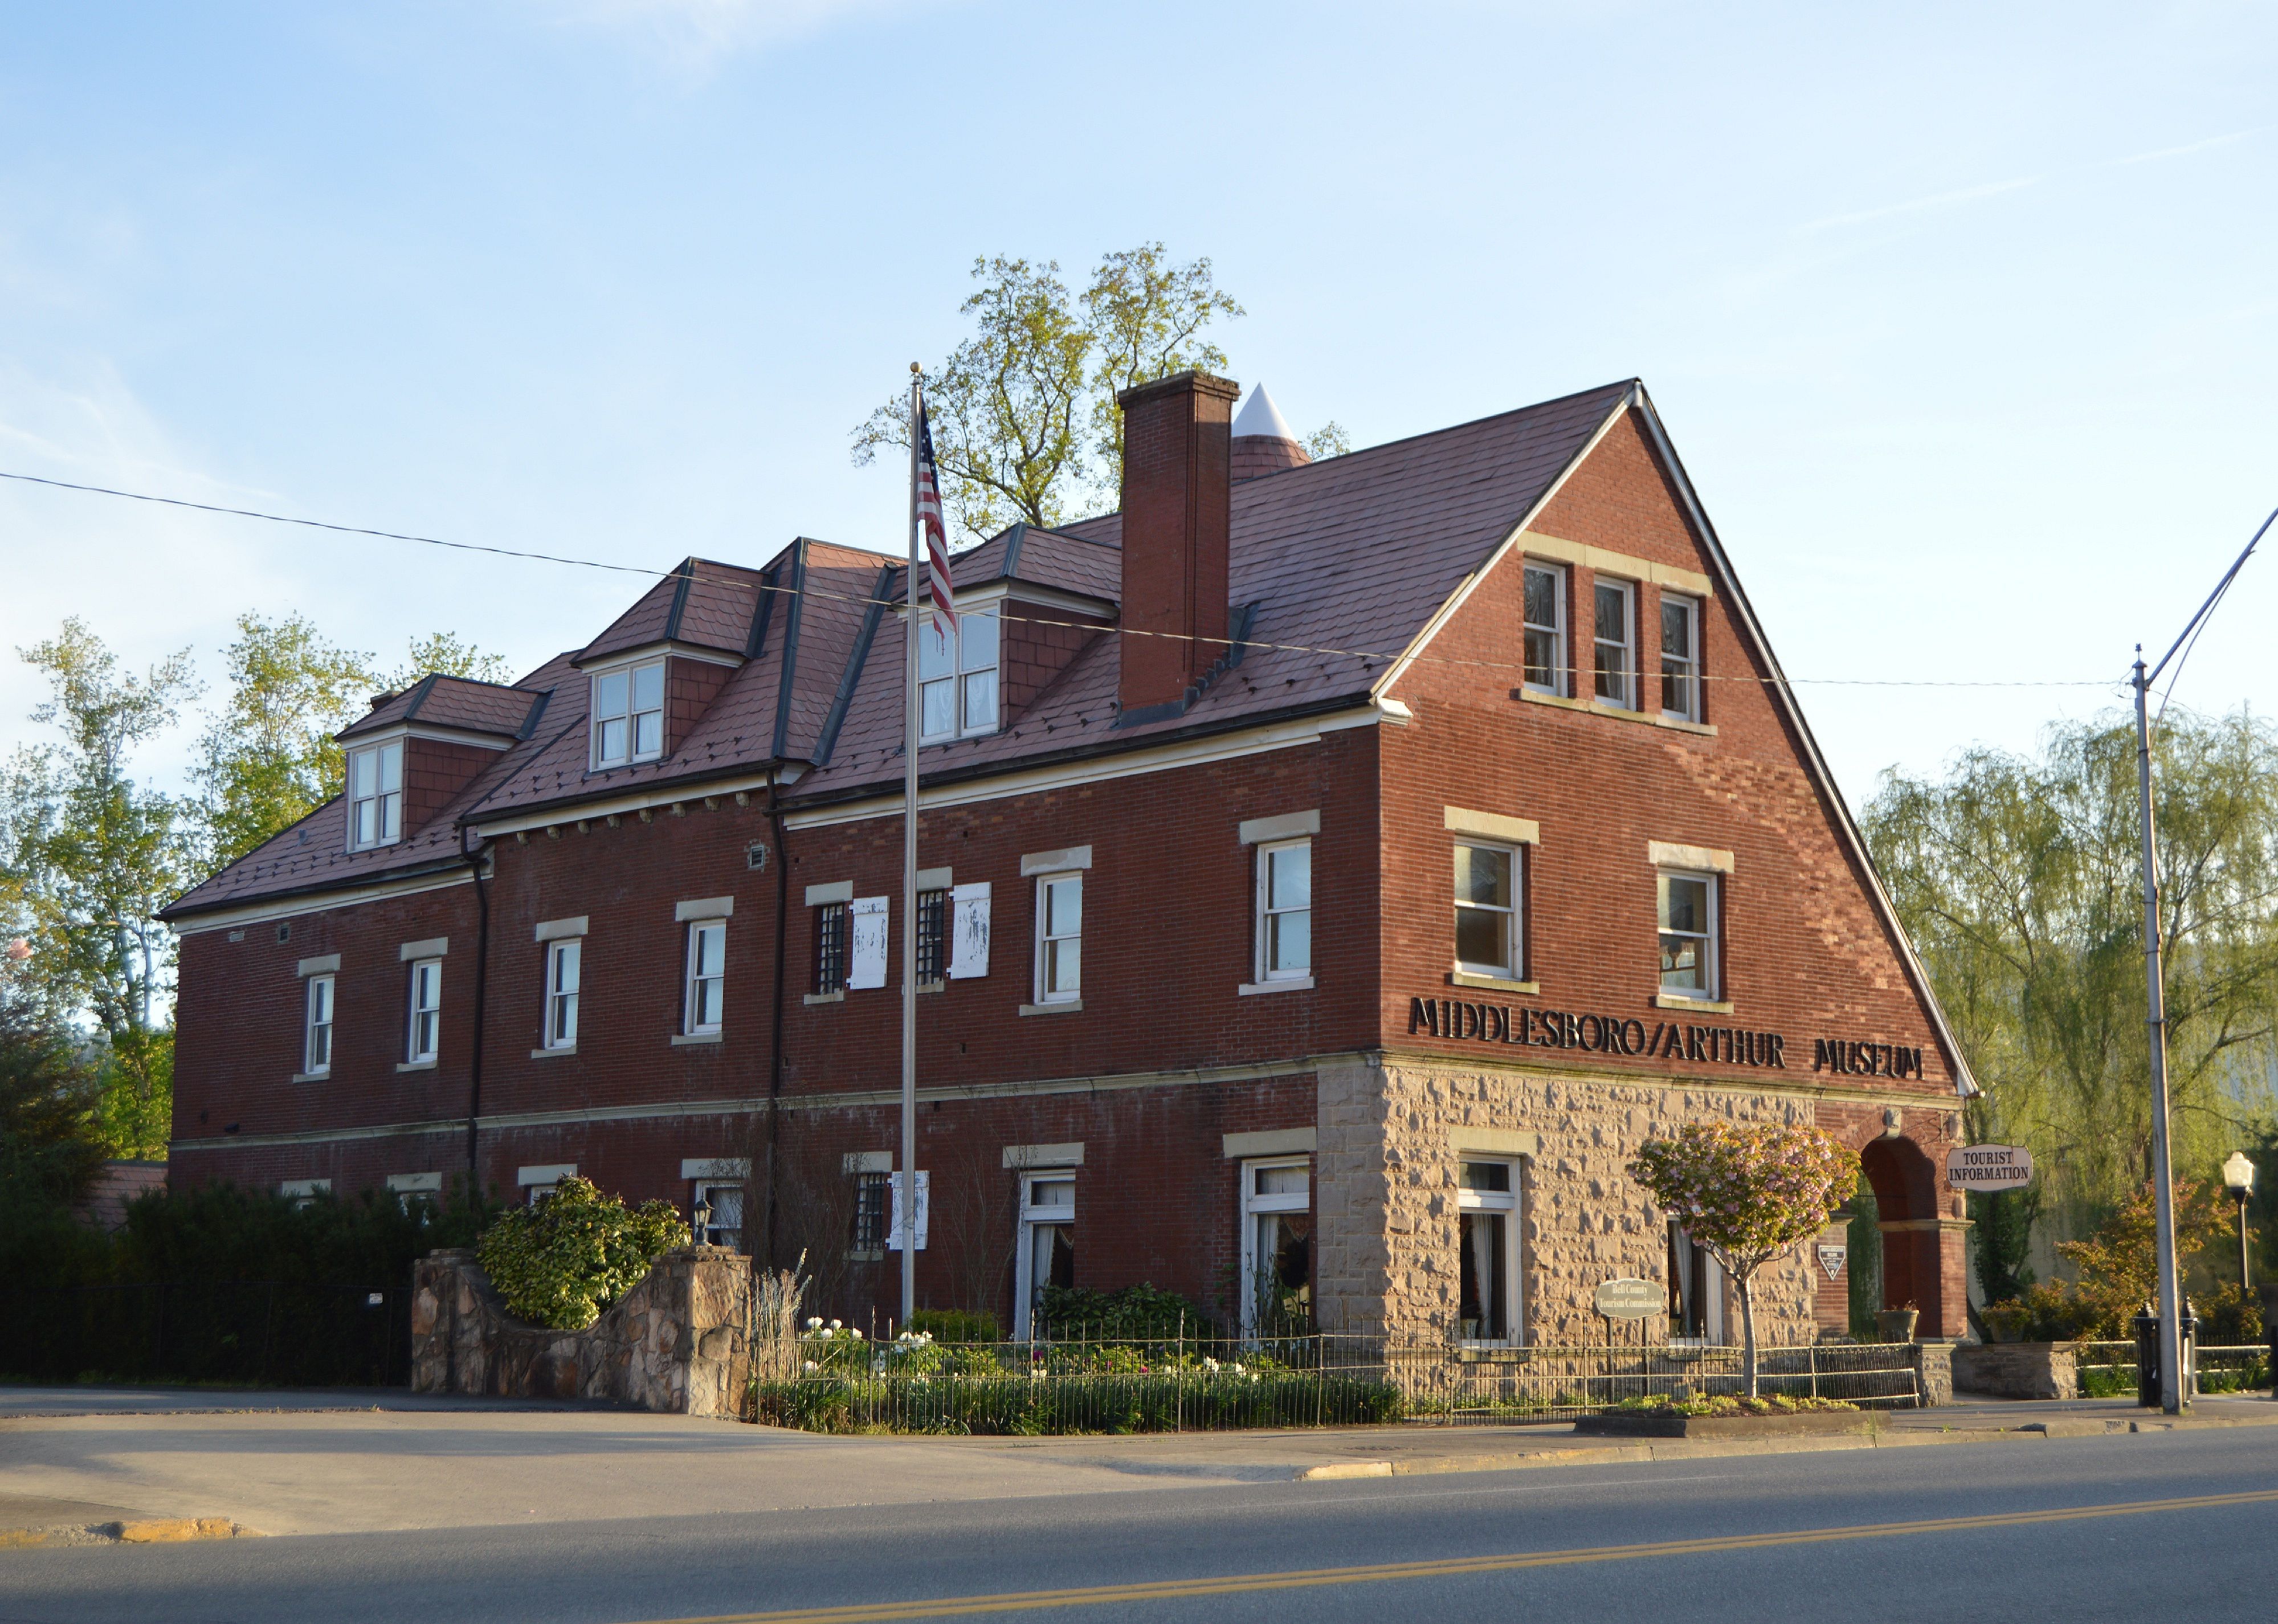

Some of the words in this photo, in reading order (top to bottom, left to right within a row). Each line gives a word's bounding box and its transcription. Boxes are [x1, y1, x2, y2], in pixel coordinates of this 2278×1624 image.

[1814, 1038, 1925, 1080] MUSEUM
[1963, 1151, 2012, 1165] TOURIST
[1949, 1166, 2028, 1181] INFORMATION
[1612, 1284, 1625, 1294] Bell
[1626, 1284, 1647, 1296] County
[1598, 1298, 1624, 1307] Tourism
[1624, 1298, 1661, 1307] Commission
